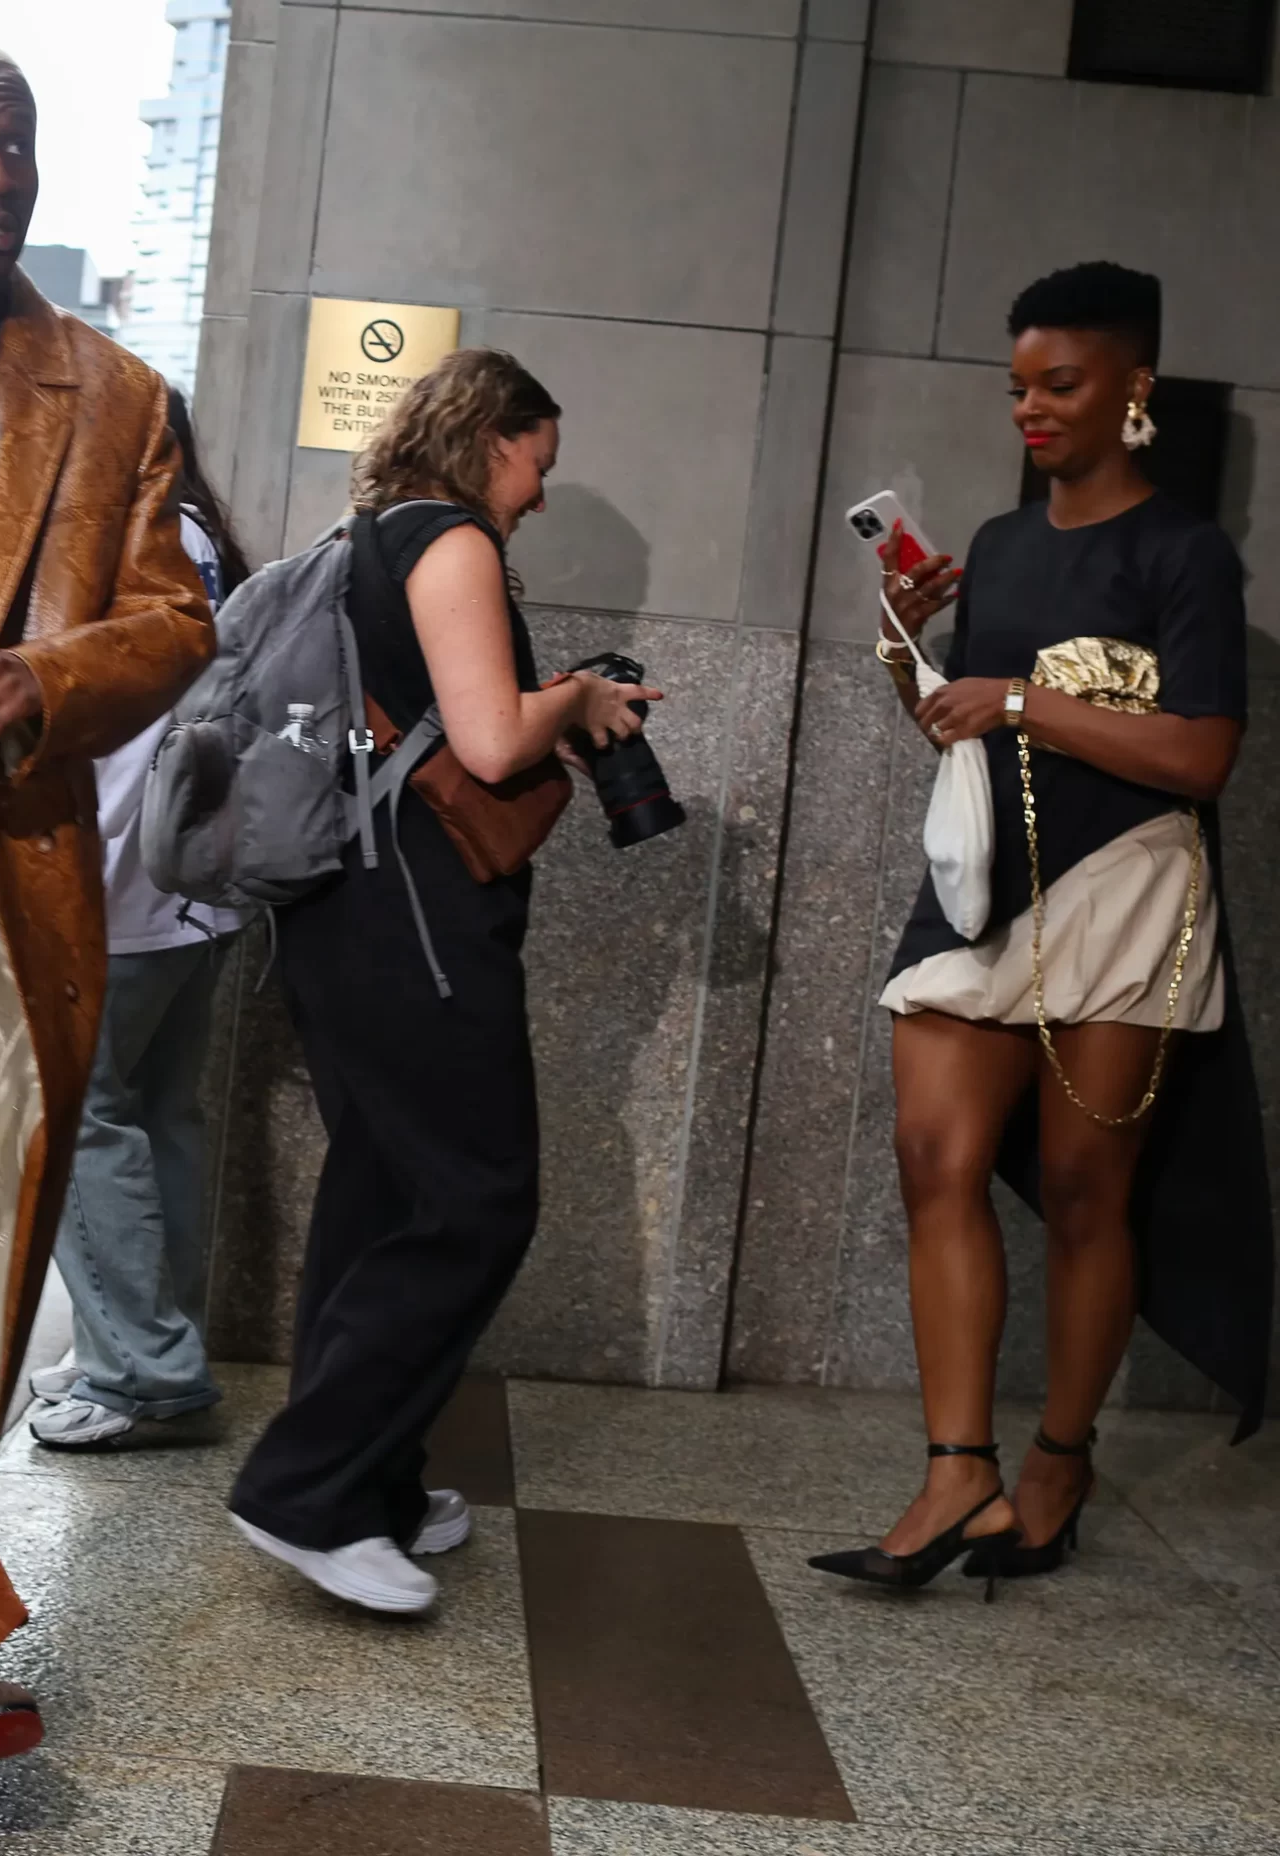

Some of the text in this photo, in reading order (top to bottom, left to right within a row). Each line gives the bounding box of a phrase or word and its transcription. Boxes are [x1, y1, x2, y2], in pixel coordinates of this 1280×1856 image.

[328, 370, 352, 384] NO
[318, 385, 371, 402] WITHIN
[321, 401, 352, 416] THE
